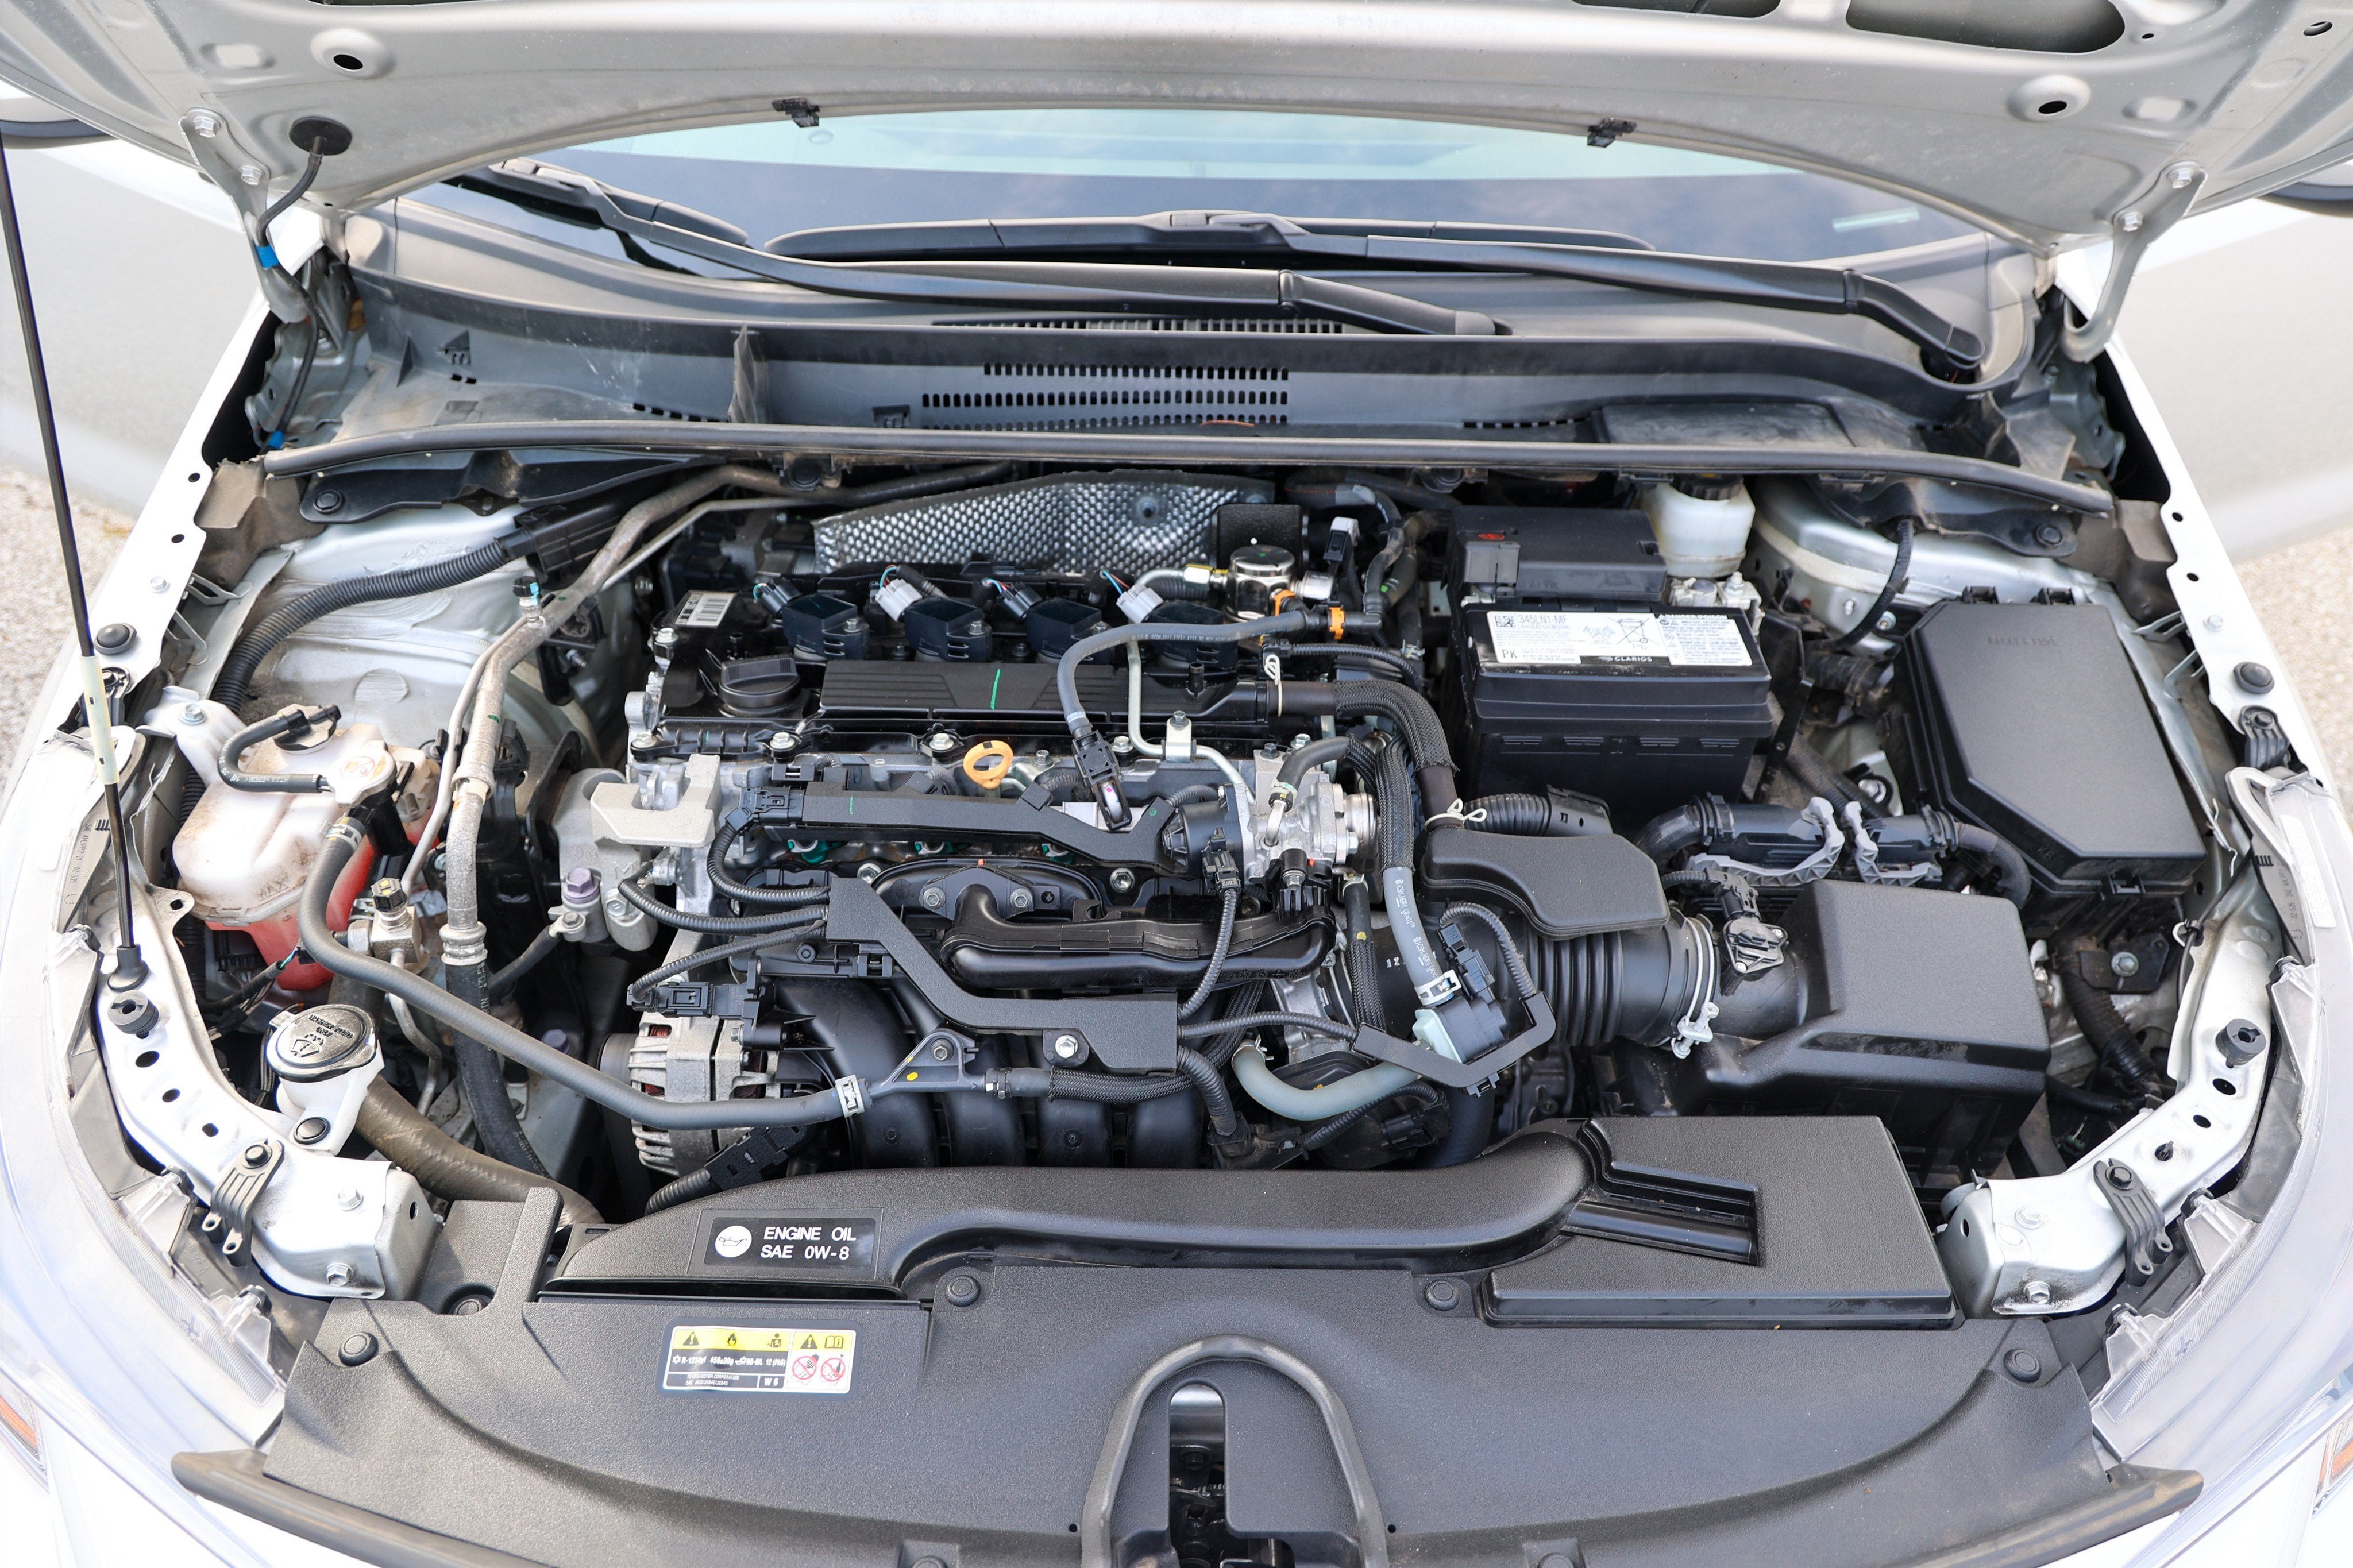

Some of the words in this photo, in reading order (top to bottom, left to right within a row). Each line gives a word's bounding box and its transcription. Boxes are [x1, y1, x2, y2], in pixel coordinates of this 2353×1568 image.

[1502, 649, 1518, 659] PK
[612, 860, 635, 880] M
[308, 1014, 335, 1030] WASHER
[334, 1027, 353, 1039] FLUID
[315, 1026, 334, 1037] ONLY
[763, 1226, 822, 1241] ENGINE
[831, 1227, 857, 1241] OIL
[760, 1244, 794, 1258] SAE
[804, 1245, 850, 1261] 0W-8
[764, 1377, 772, 1386] W
[773, 1377, 779, 1387] 6
